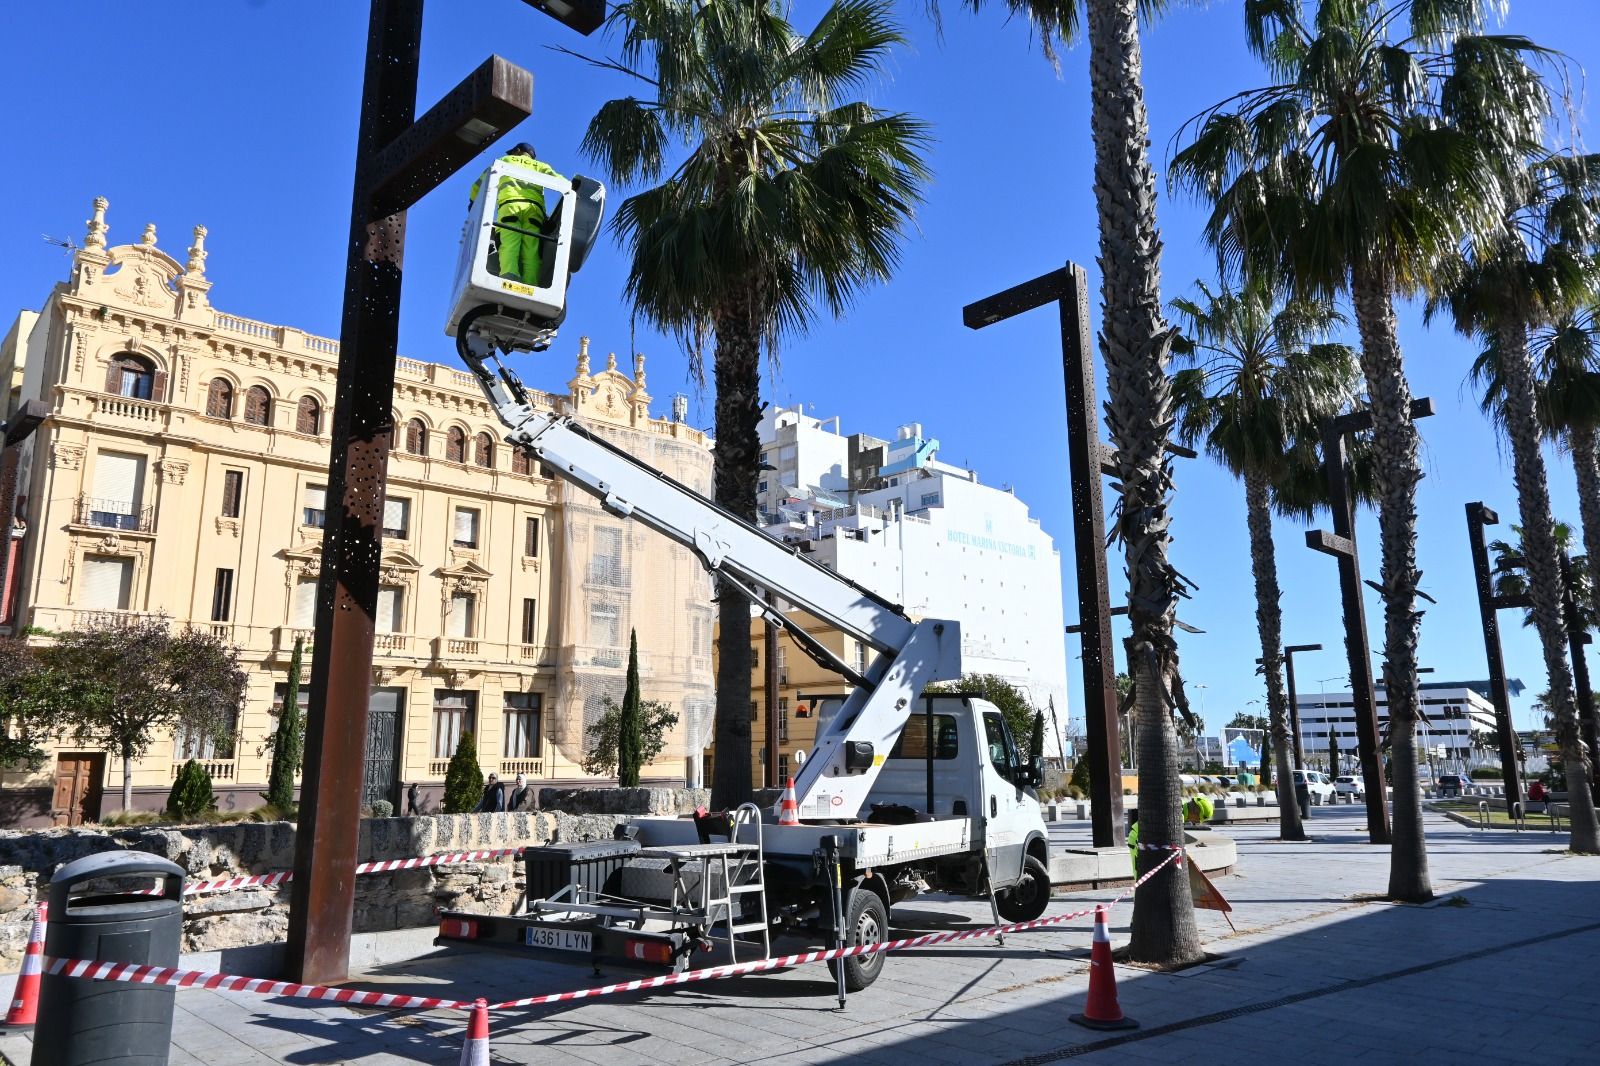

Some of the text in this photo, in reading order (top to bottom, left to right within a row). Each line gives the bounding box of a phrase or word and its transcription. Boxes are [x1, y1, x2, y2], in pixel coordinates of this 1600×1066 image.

[947, 529, 970, 545] HOTEL
[971, 535, 997, 551] MARINA
[997, 541, 1026, 557] VICTORIA
[533, 929, 589, 949] 4361 LYN
